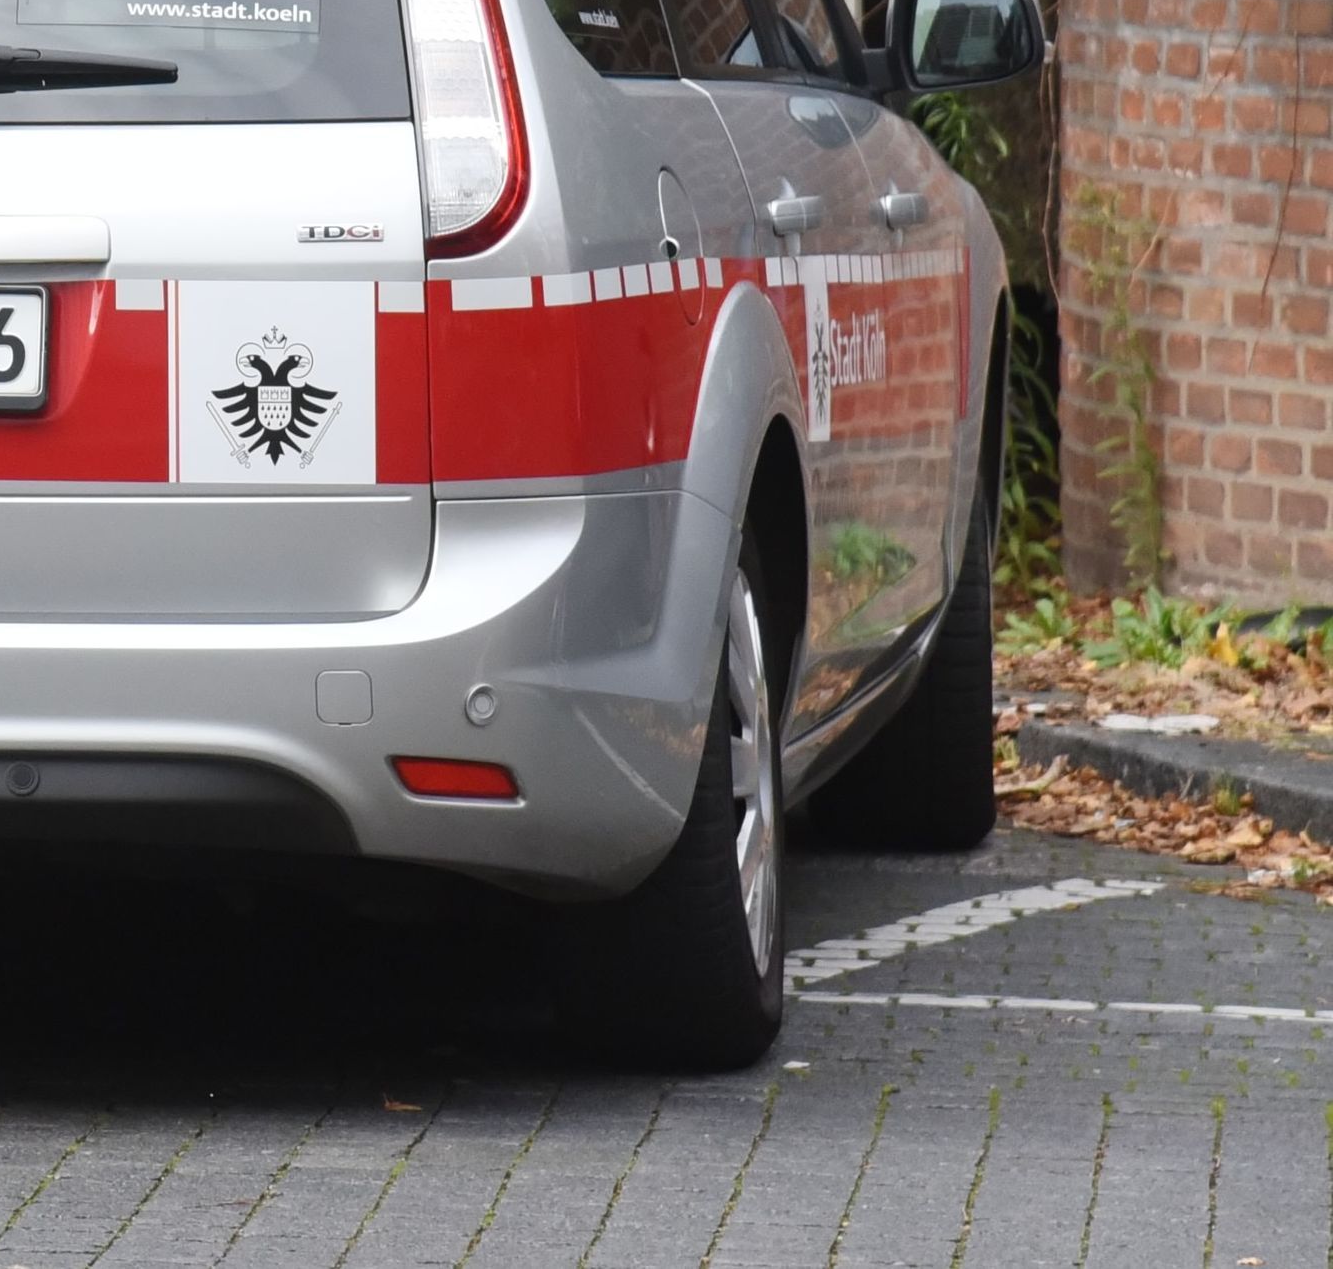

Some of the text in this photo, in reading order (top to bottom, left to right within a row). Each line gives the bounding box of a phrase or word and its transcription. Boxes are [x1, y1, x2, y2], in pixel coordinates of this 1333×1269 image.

[126, 1, 313, 23] www.stadt.koeln
[301, 225, 381, 239] TDCi
[830, 307, 886, 387] Stadt Köln
